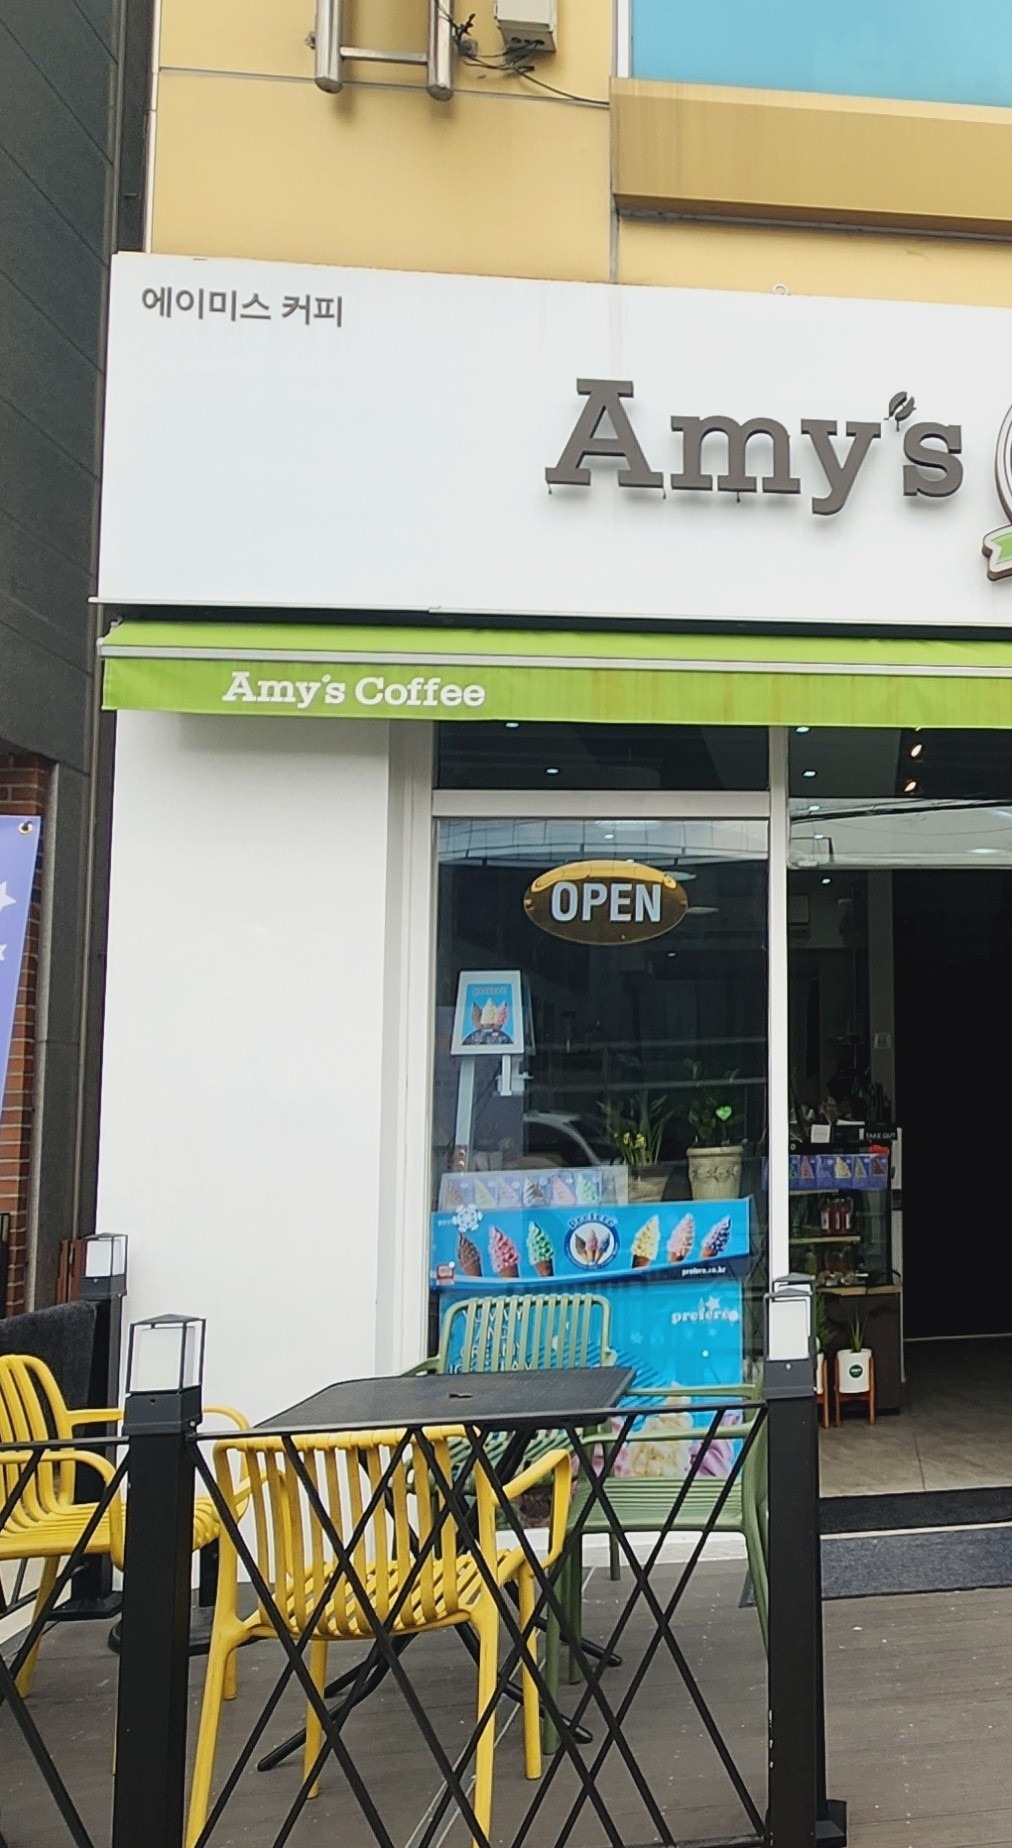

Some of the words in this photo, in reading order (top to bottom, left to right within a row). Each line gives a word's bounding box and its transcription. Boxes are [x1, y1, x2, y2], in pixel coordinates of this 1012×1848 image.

[141, 286, 271, 322] 에이미스
[281, 294, 343, 328] 커피
[545, 377, 964, 516] Amy's
[222, 671, 346, 709] Amy's
[354, 676, 486, 706] Coffee
[551, 881, 662, 923] OPEN
